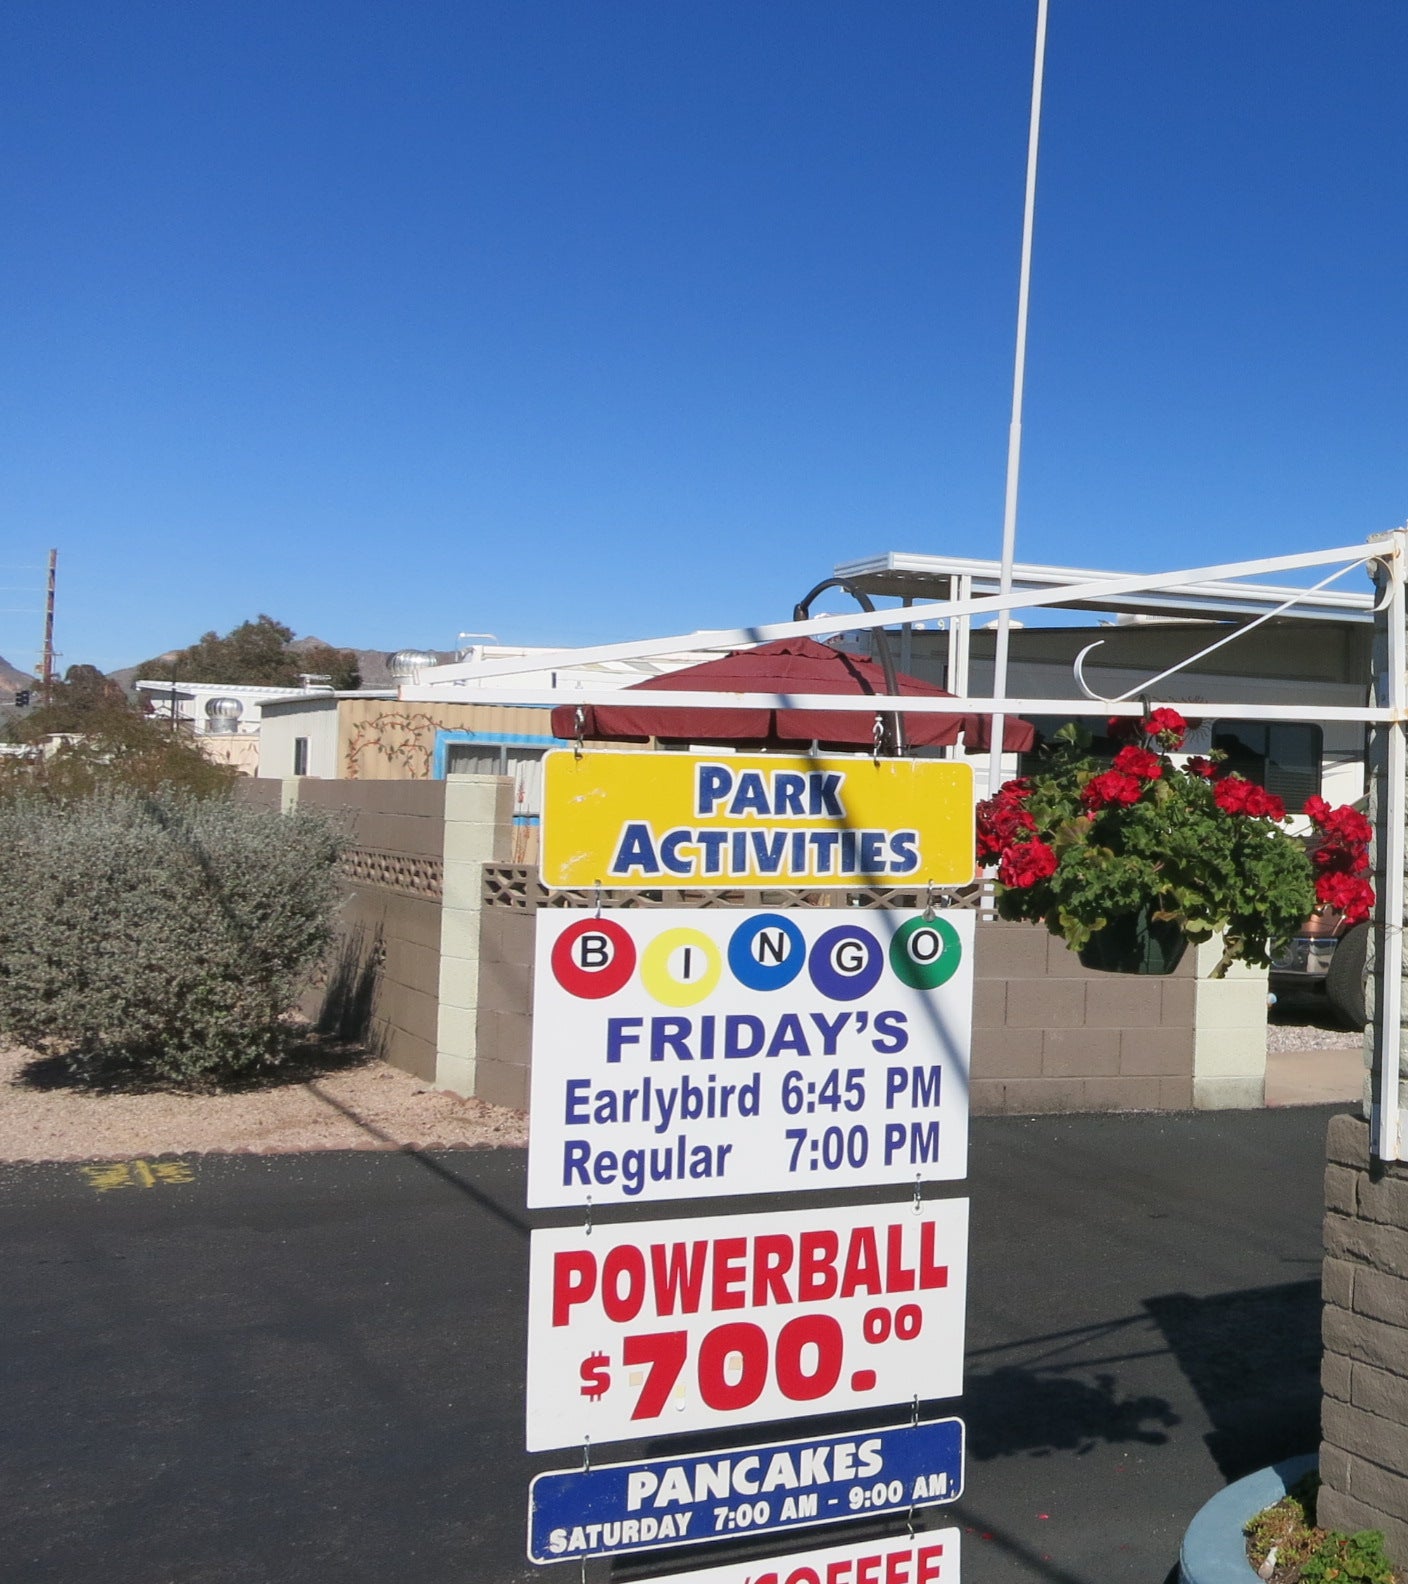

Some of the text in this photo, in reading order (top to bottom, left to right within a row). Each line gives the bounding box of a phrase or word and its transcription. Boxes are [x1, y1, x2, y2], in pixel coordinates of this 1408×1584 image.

[697, 763, 845, 818] PARK
[610, 822, 919, 875] ACTIVITIES
[605, 1010, 910, 1063] FRIDAY'S
[564, 1065, 942, 1134] Earlybird 6:45 PM
[561, 1120, 941, 1196] Regular 7:00 PM
[551, 1220, 949, 1328] POWERBALL
[626, 1438, 884, 1512] PANCAKES
[548, 1511, 693, 1554] SATURDAY
[713, 1505, 771, 1531] 7:00
[779, 1492, 819, 1522] AM
[848, 1479, 904, 1510] 9:00
